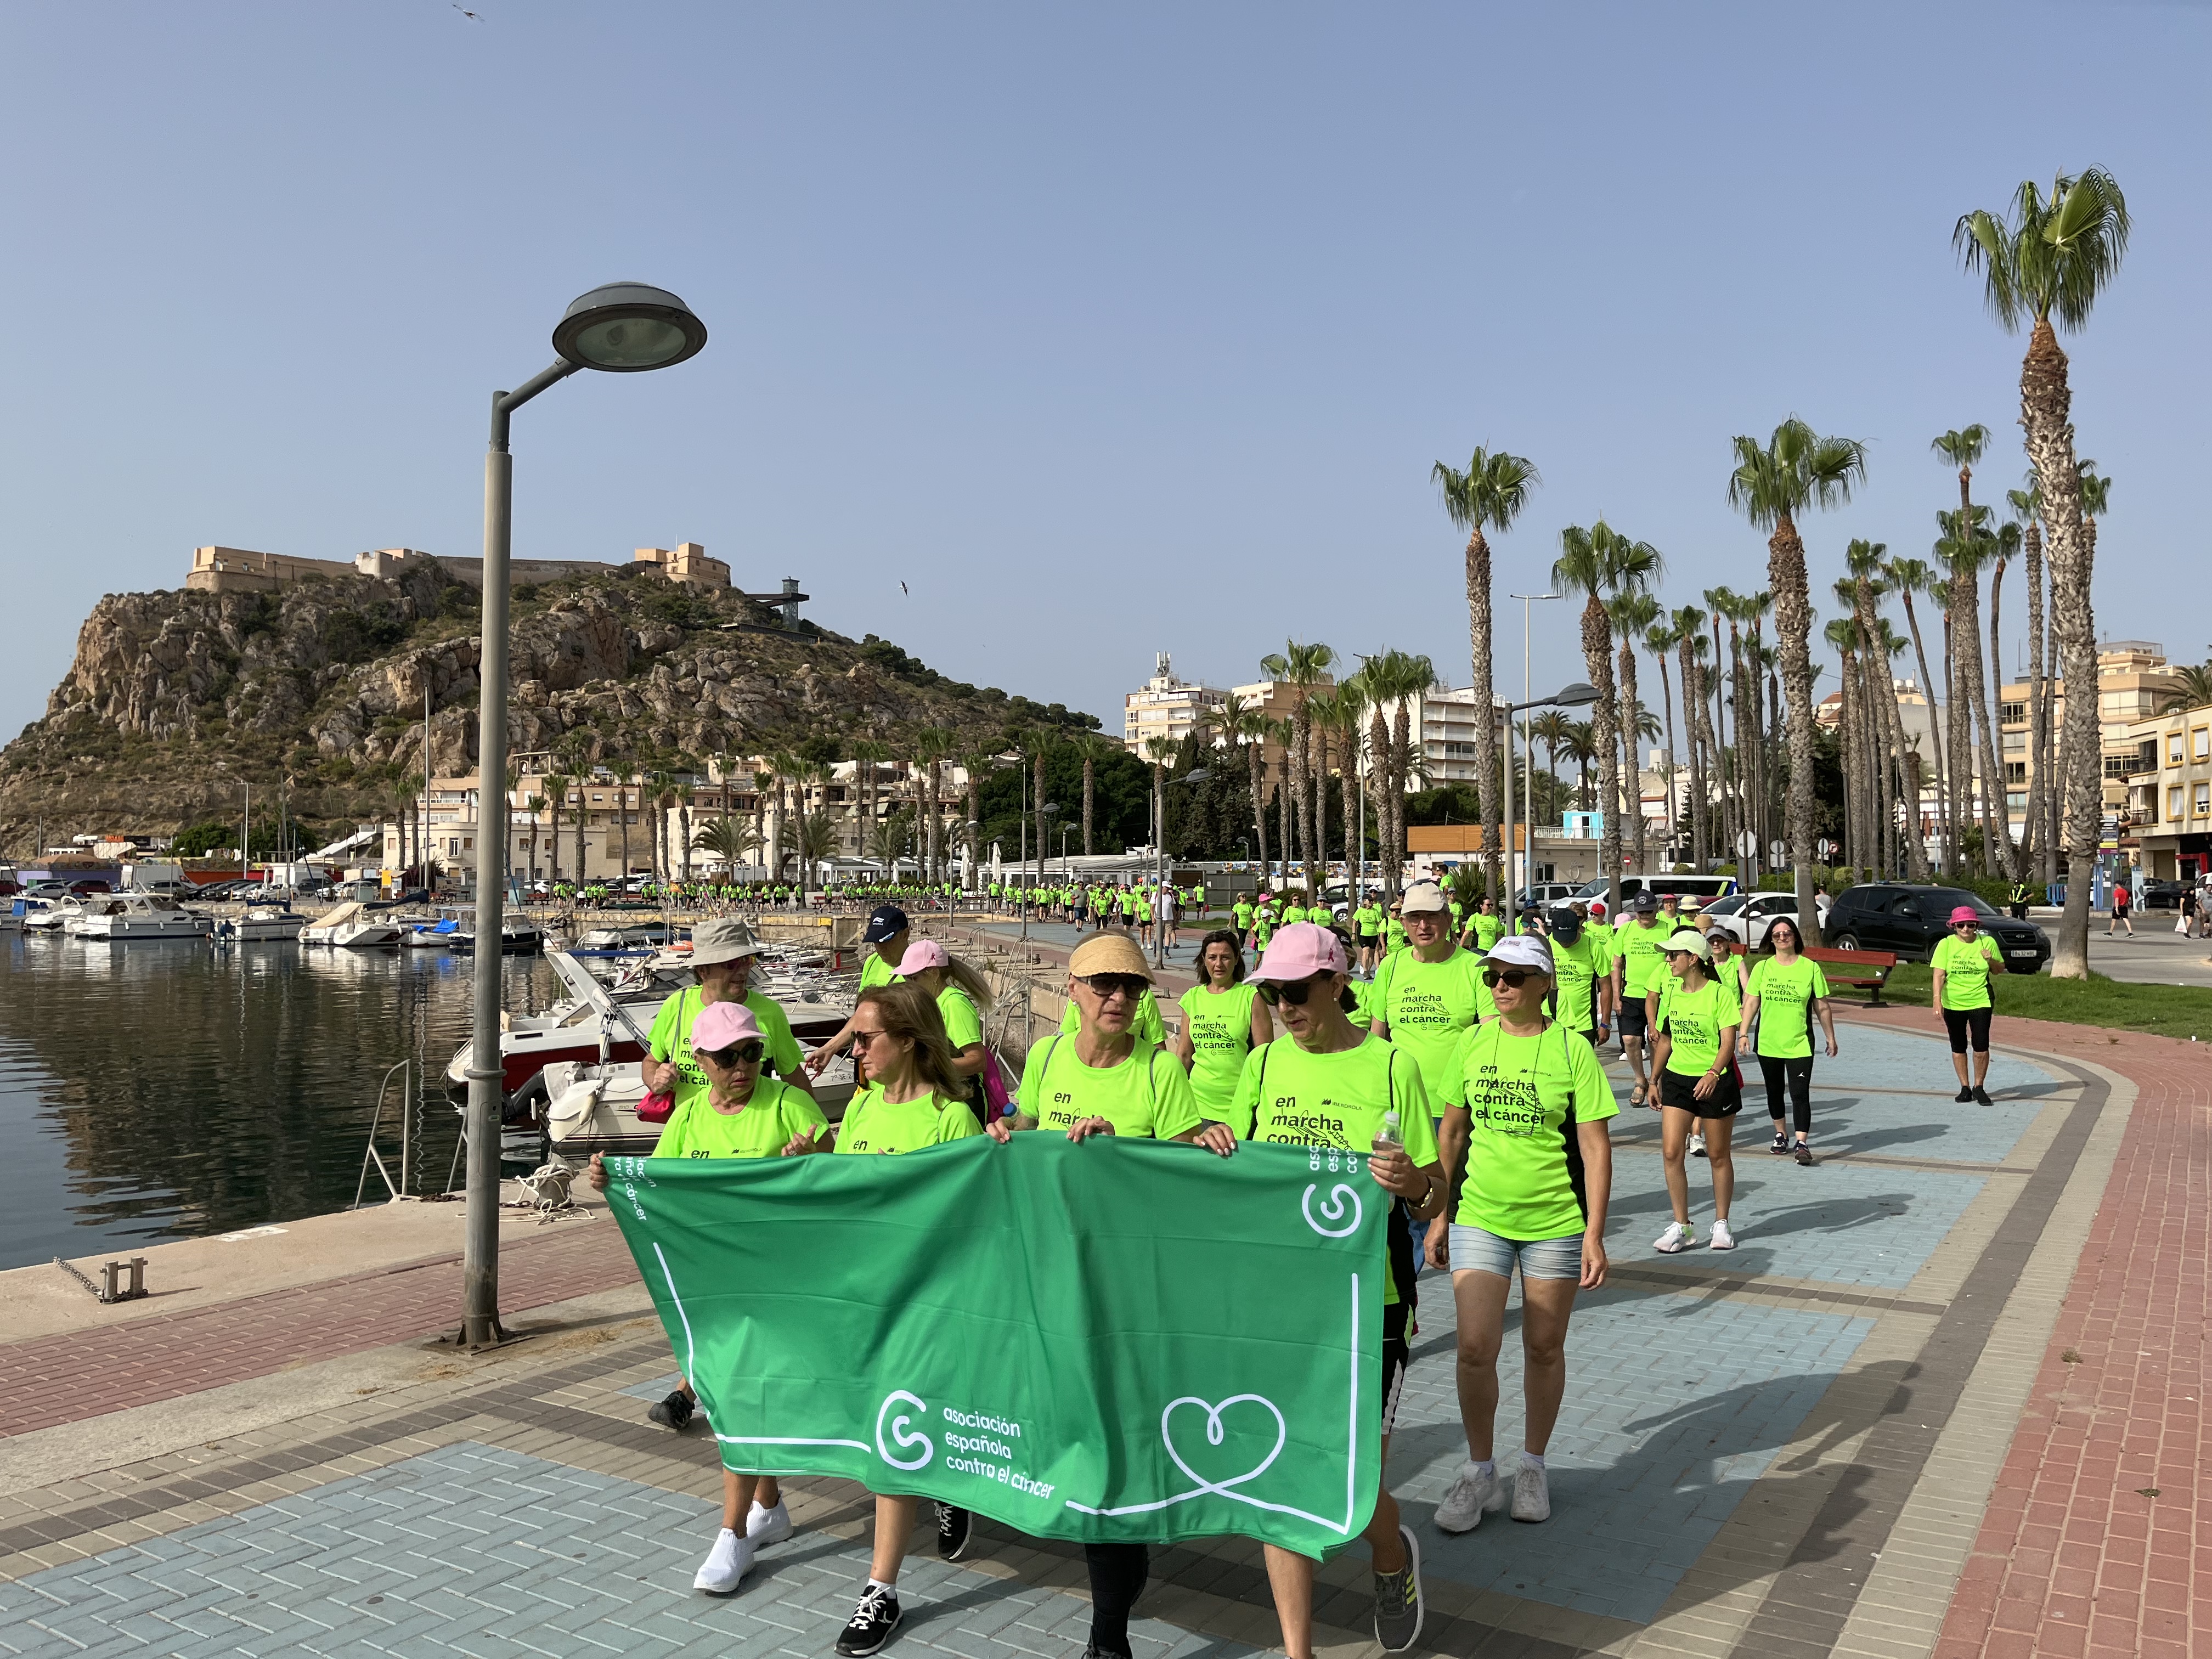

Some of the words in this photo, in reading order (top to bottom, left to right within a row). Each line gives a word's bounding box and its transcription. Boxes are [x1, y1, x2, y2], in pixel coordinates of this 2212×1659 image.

[1402, 994, 1442, 1003] marcha
[1400, 1015, 1410, 1023] el
[1412, 1014, 1451, 1023] cáncer
[1670, 1019, 1699, 1027] marcha
[1195, 1040, 1202, 1048] el
[1203, 1040, 1235, 1048] cáncer
[678, 1063, 699, 1071] con
[1480, 1065, 1498, 1074] en
[680, 1074, 689, 1084] el
[691, 1075, 710, 1086] cán
[1476, 1078, 1536, 1092] marcha
[1054, 1092, 1071, 1104] en
[1276, 1096, 1296, 1107] en
[1474, 1093, 1525, 1107] contra
[1332, 1102, 1362, 1110] IBERDROLA
[1048, 1110, 1095, 1126] mar
[1271, 1113, 1344, 1131] marcha
[1475, 1107, 1491, 1119] el
[1493, 1108, 1545, 1125] cáncer
[854, 1140, 867, 1150] en
[1267, 1133, 1331, 1148] contra
[691, 1150, 710, 1159] en
[625, 1183, 647, 1221] cáncer
[944, 1406, 1021, 1437] asociación
[945, 1431, 1012, 1460] española
[946, 1455, 995, 1479] contra
[997, 1465, 1011, 1485] el
